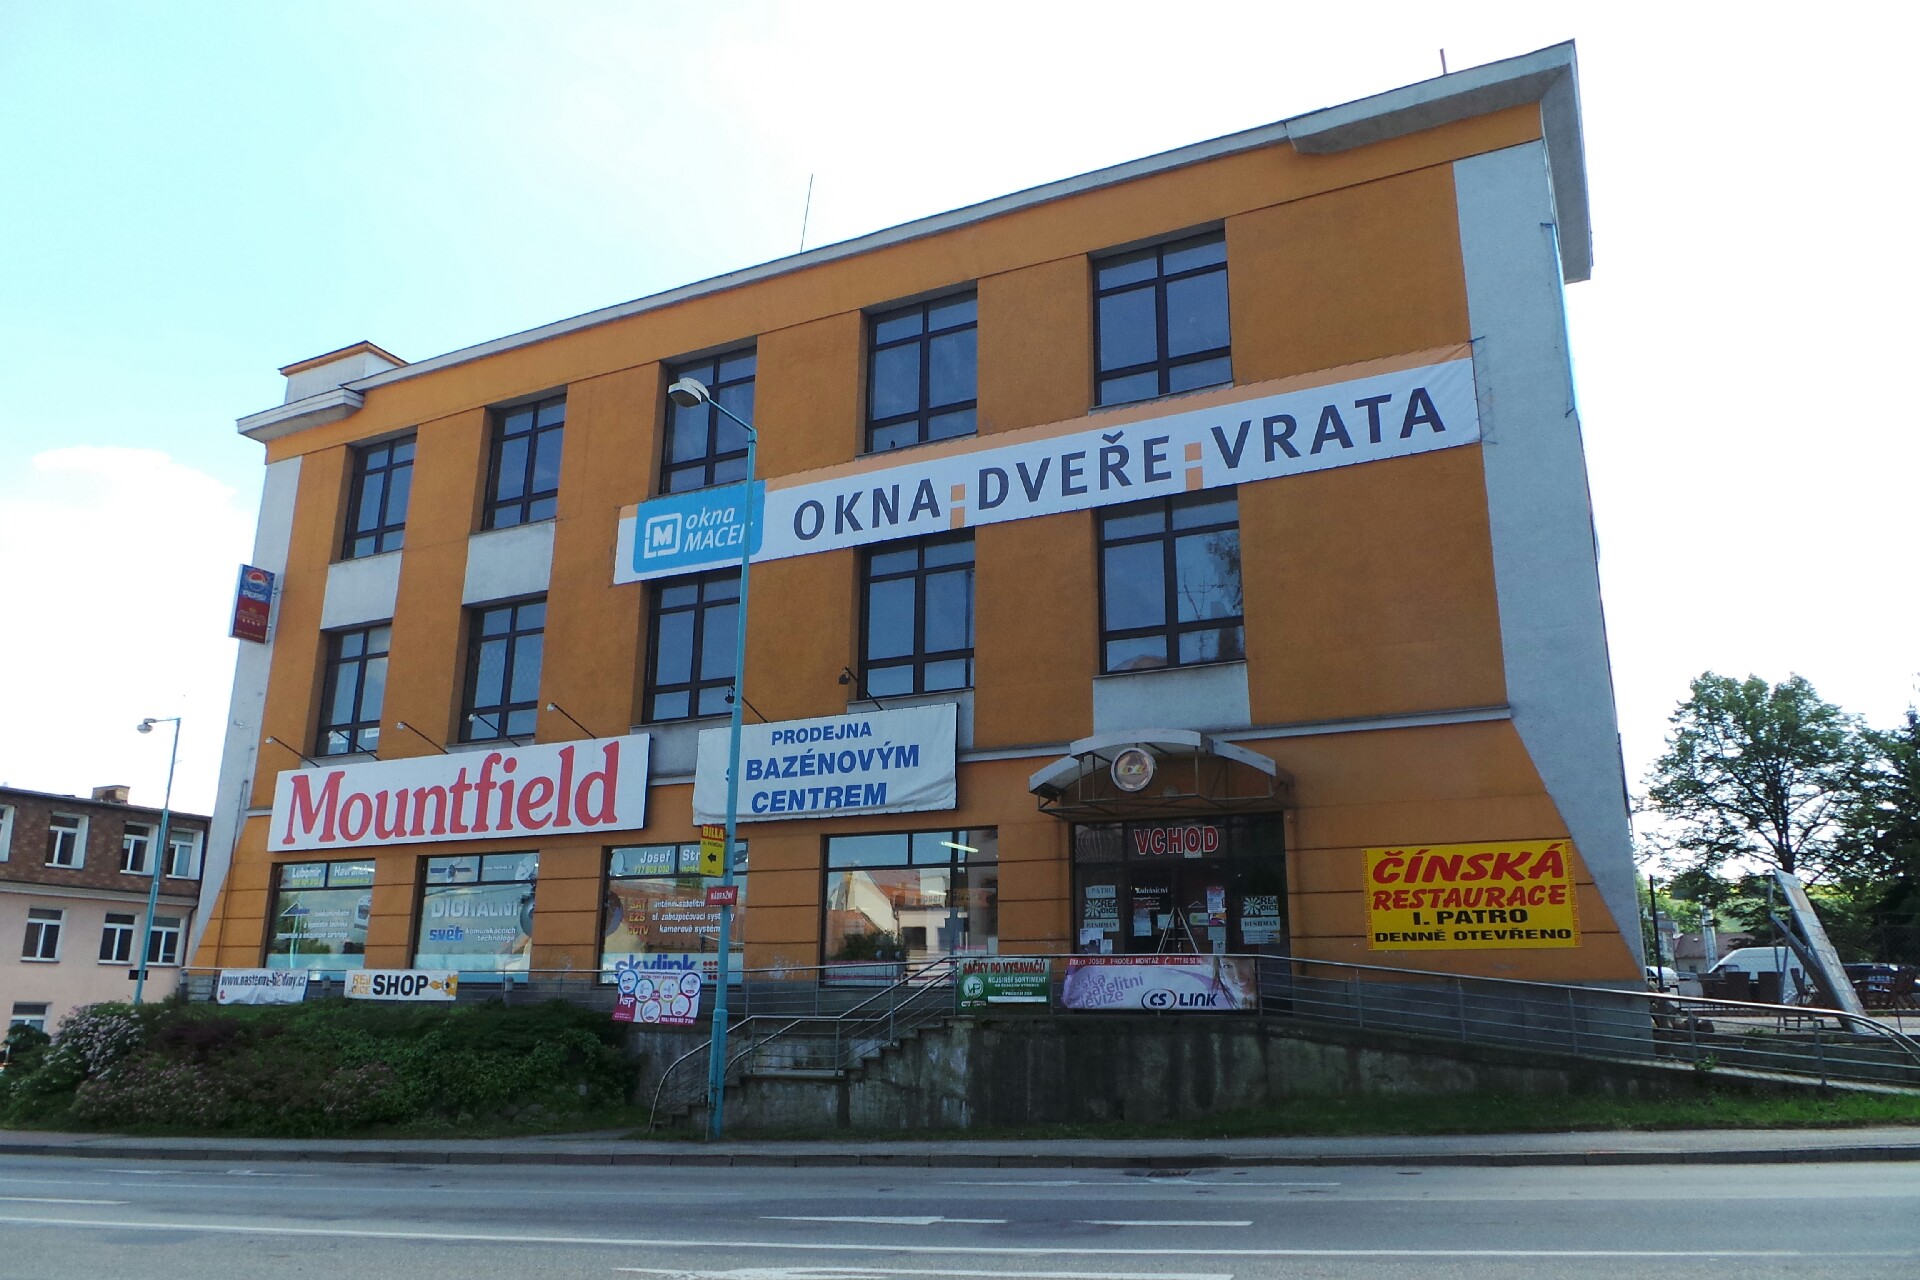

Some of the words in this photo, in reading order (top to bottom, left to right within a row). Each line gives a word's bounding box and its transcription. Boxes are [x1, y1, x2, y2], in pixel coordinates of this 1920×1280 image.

[793, 478, 941, 541] OKNA
[978, 430, 1172, 510] DVEŘE
[1211, 387, 1447, 469] VRATA
[685, 506, 735, 530] okna
[771, 722, 872, 746] PRODEJNA
[745, 741, 919, 781] BAZÉNOVÝM
[282, 741, 620, 845] Mountfield
[751, 782, 887, 813] CENTREM
[702, 826, 724, 840] BILLA
[1133, 826, 1219, 855] VCHOD
[640, 851, 671, 864] Josef
[682, 849, 701, 862] Str
[1372, 843, 1564, 884] ČÍNSKÁ
[1372, 884, 1567, 912] RESTAURACE
[431, 898, 519, 918] DIGITÁLNÍ
[628, 913, 646, 922] EZS
[707, 912, 735, 923] systy
[1436, 908, 1529, 925] PATRO
[429, 924, 465, 942] svět
[659, 924, 693, 934] kamerové
[694, 924, 721, 935] systém
[1375, 929, 1447, 942] DENNĚ
[1453, 928, 1572, 941] OTEVŘENO
[963, 960, 988, 974] SÁČKY
[990, 962, 1001, 974] DO
[1002, 959, 1045, 974] VYSAVAČŮ
[1088, 957, 1106, 965] JOSEF
[1111, 957, 1133, 965] PRODEJ
[372, 974, 429, 996] SHOP
[1073, 972, 1106, 989] eská
[1086, 972, 1144, 997] satelitní
[1149, 992, 1167, 1007] CS
